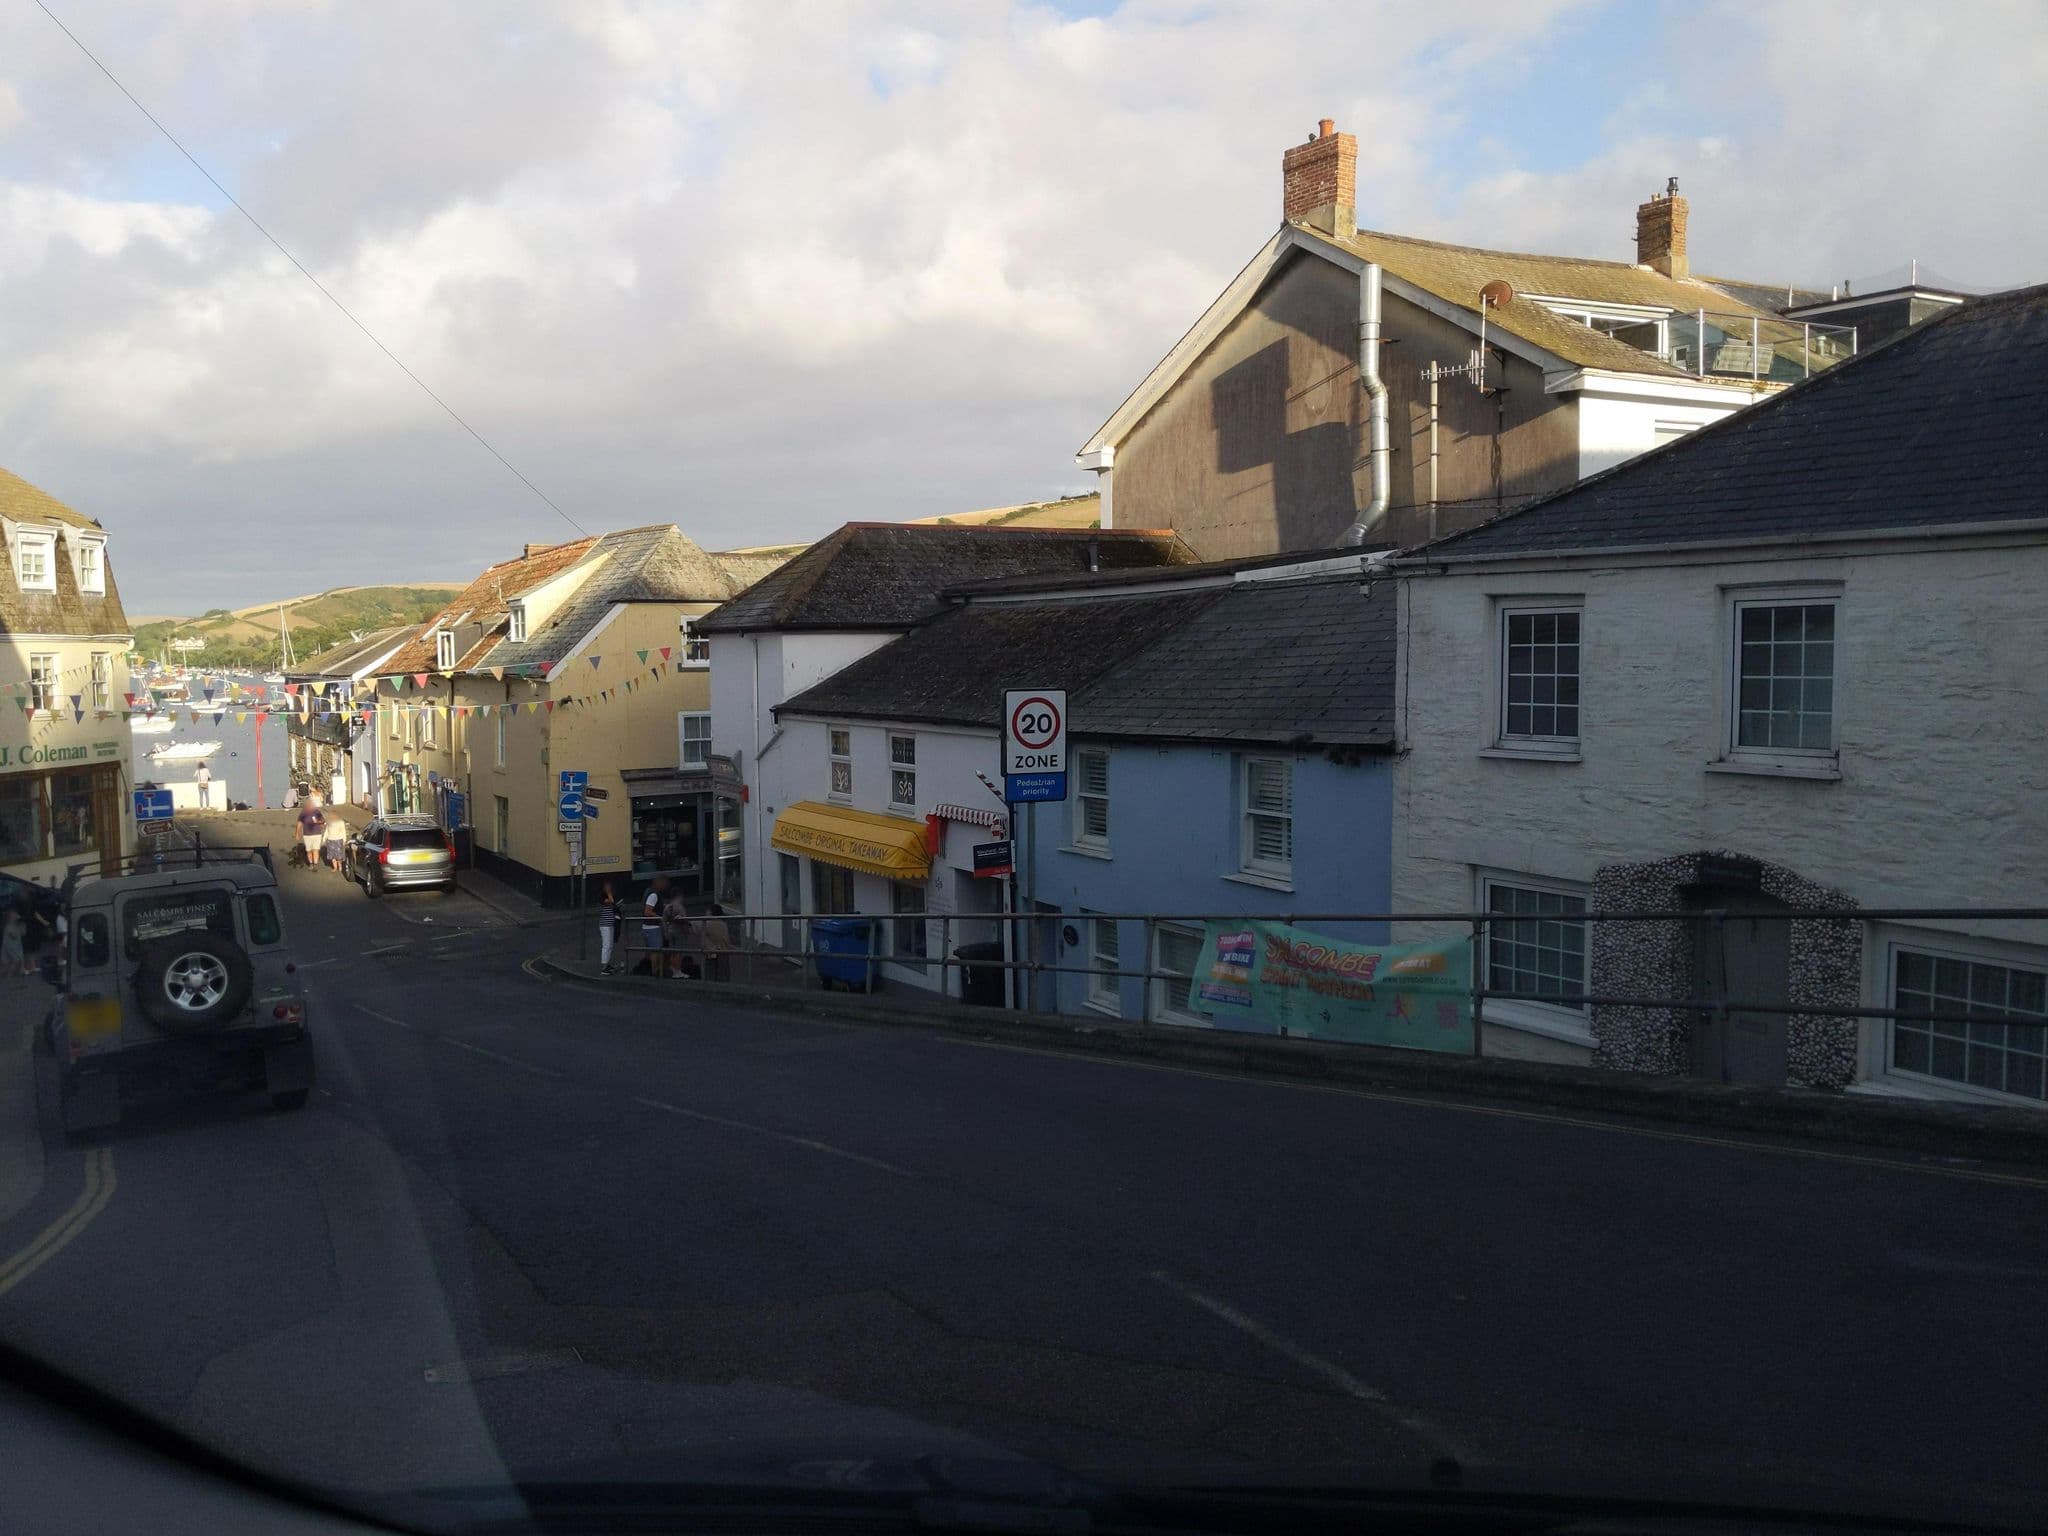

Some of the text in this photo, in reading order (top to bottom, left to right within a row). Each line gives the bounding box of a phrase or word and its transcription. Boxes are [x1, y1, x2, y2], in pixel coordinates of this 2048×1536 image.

[1021, 713, 1052, 735] 20
[18, 744, 88, 765] Coleman
[1015, 754, 1059, 769] ZONE
[1016, 777, 1056, 787] Pedestrian
[1022, 786, 1050, 797] priority
[779, 825, 814, 845] SALCOMBE
[815, 834, 846, 852] ORIGINAL
[849, 841, 888, 861] TAKEAWAY
[1265, 934, 1381, 977] SALCOMBE
